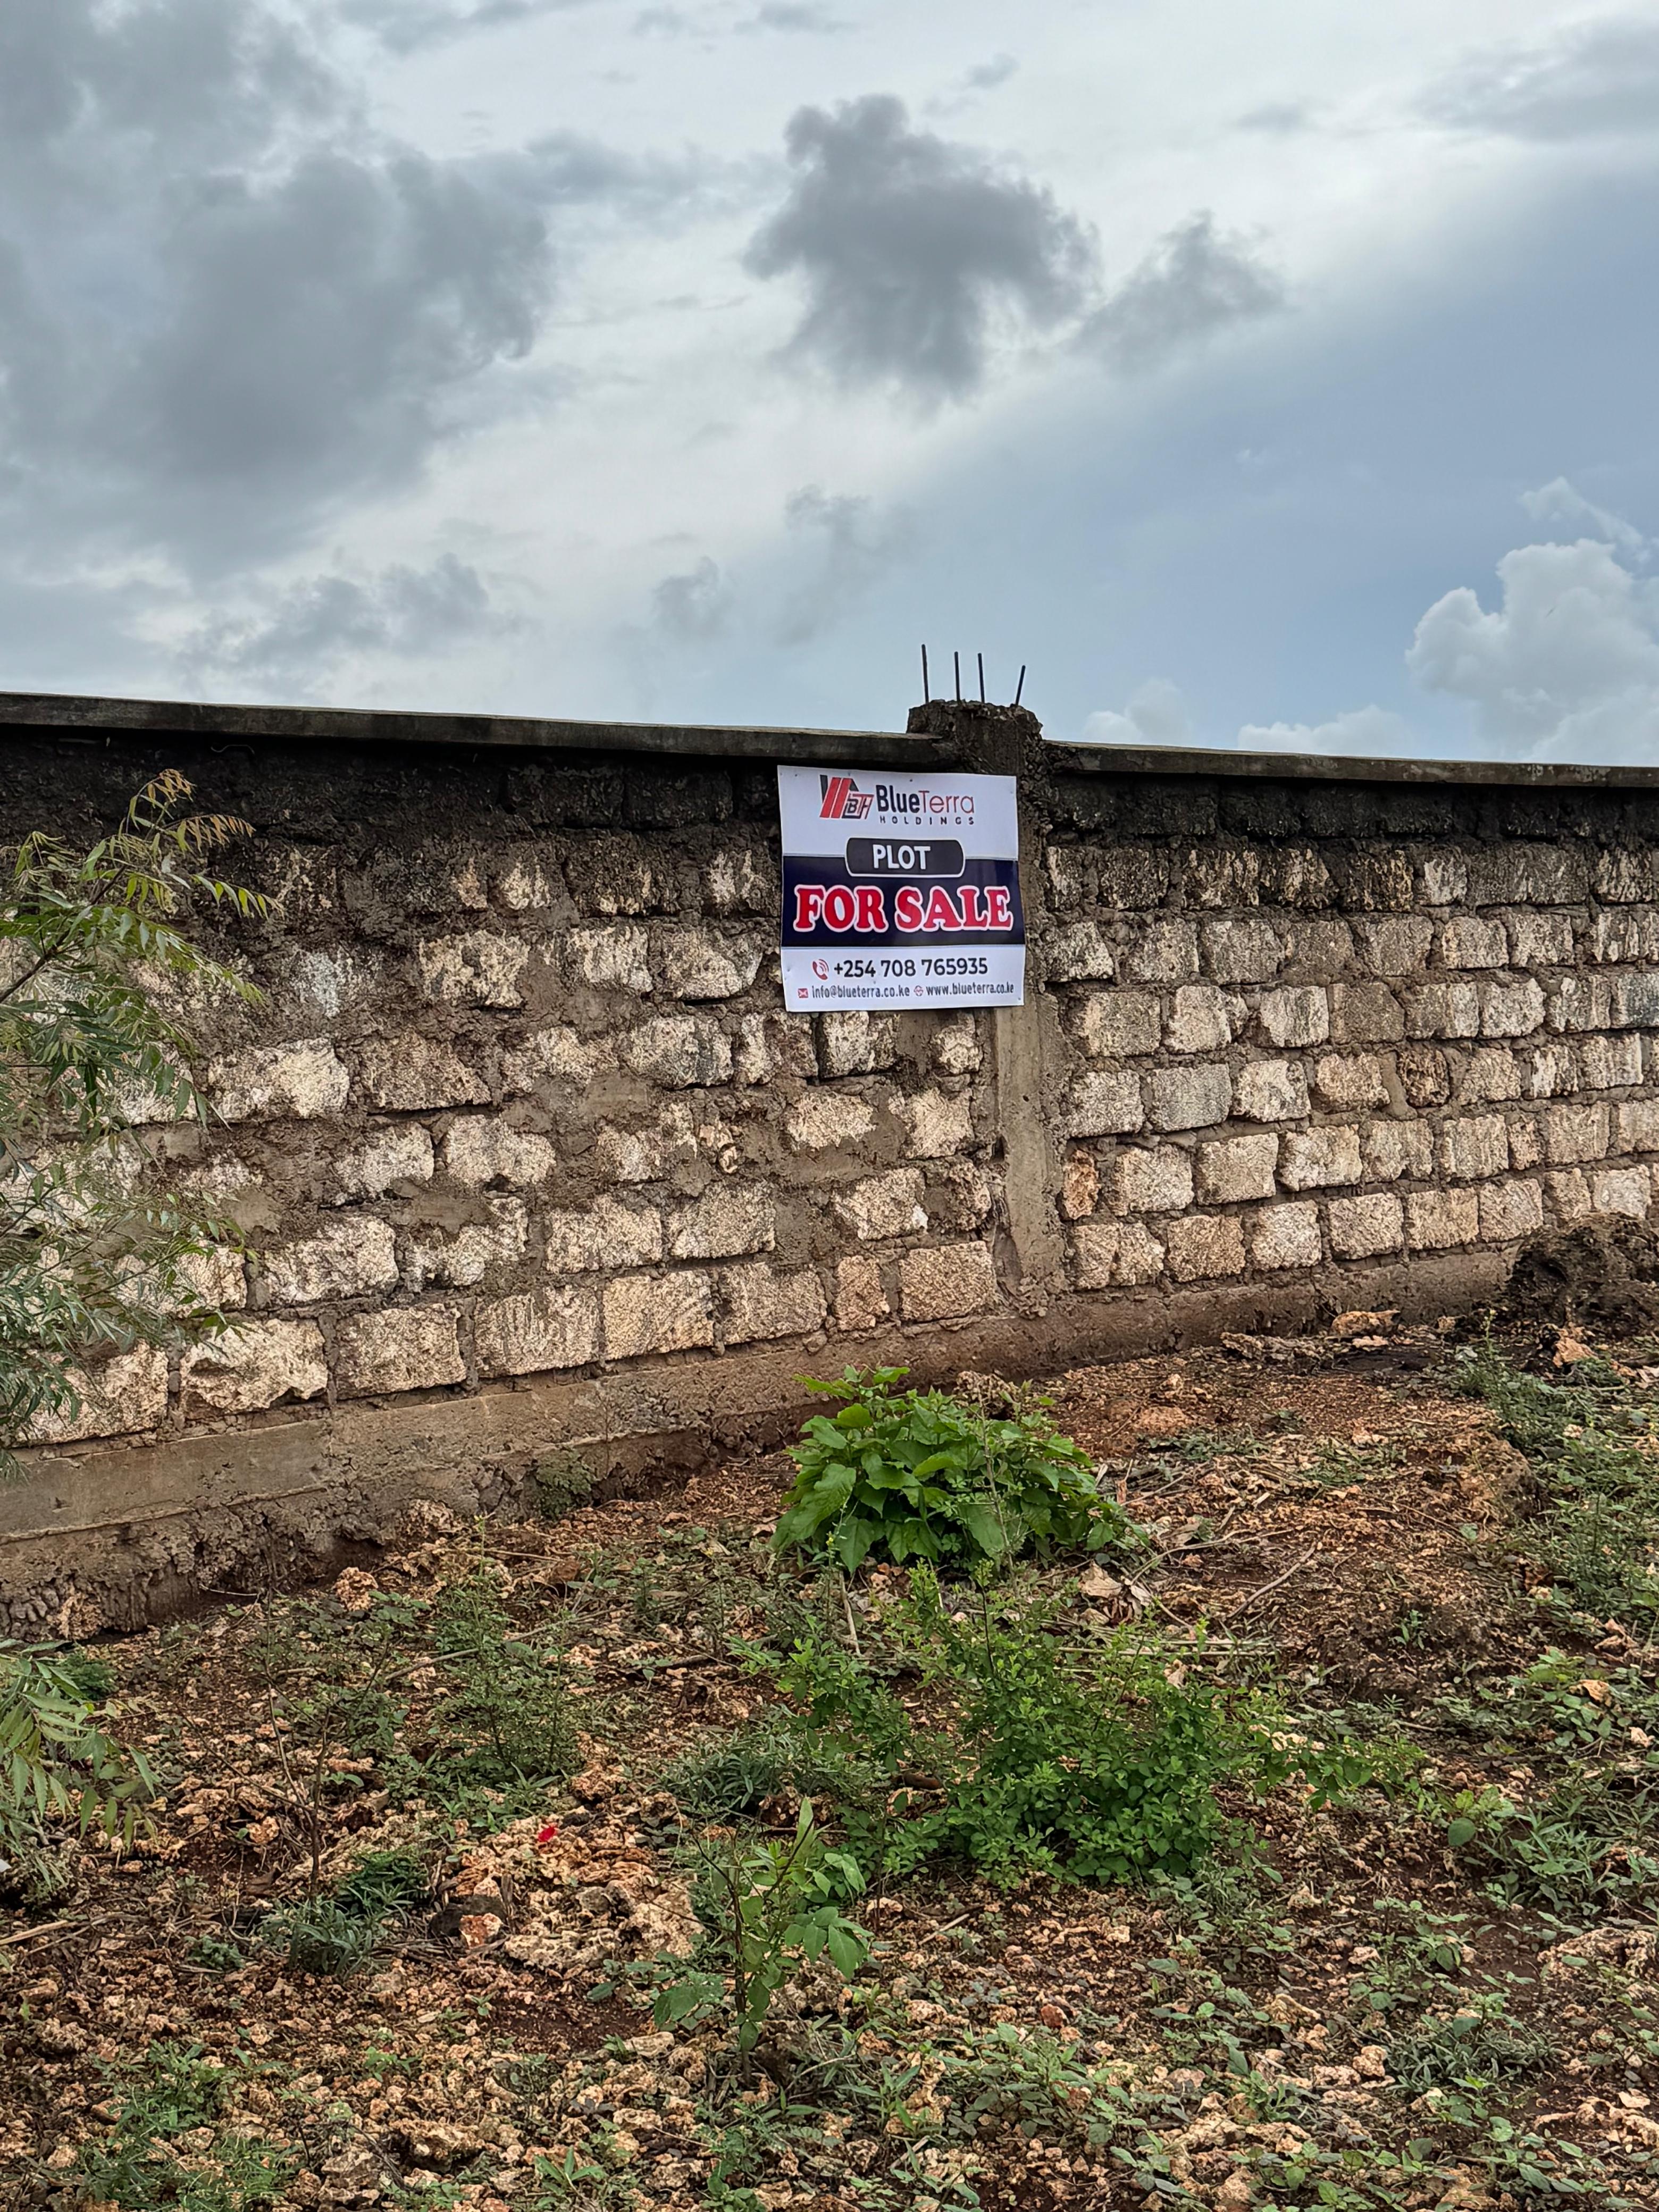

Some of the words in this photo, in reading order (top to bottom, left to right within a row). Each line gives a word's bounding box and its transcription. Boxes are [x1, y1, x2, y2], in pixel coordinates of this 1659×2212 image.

[875, 784, 975, 814] BlueTerra
[880, 816, 975, 825] HOLDINGS
[872, 844, 931, 870] PLOT
[793, 885, 889, 932] FOR
[894, 885, 1013, 932] SALE
[834, 959, 876, 977] +254
[881, 959, 916, 977] 708
[921, 957, 988, 976] 765935
[812, 985, 910, 999] info@blueterra.co.ke
[926, 981, 1015, 996] www.blueterra.co.ke
